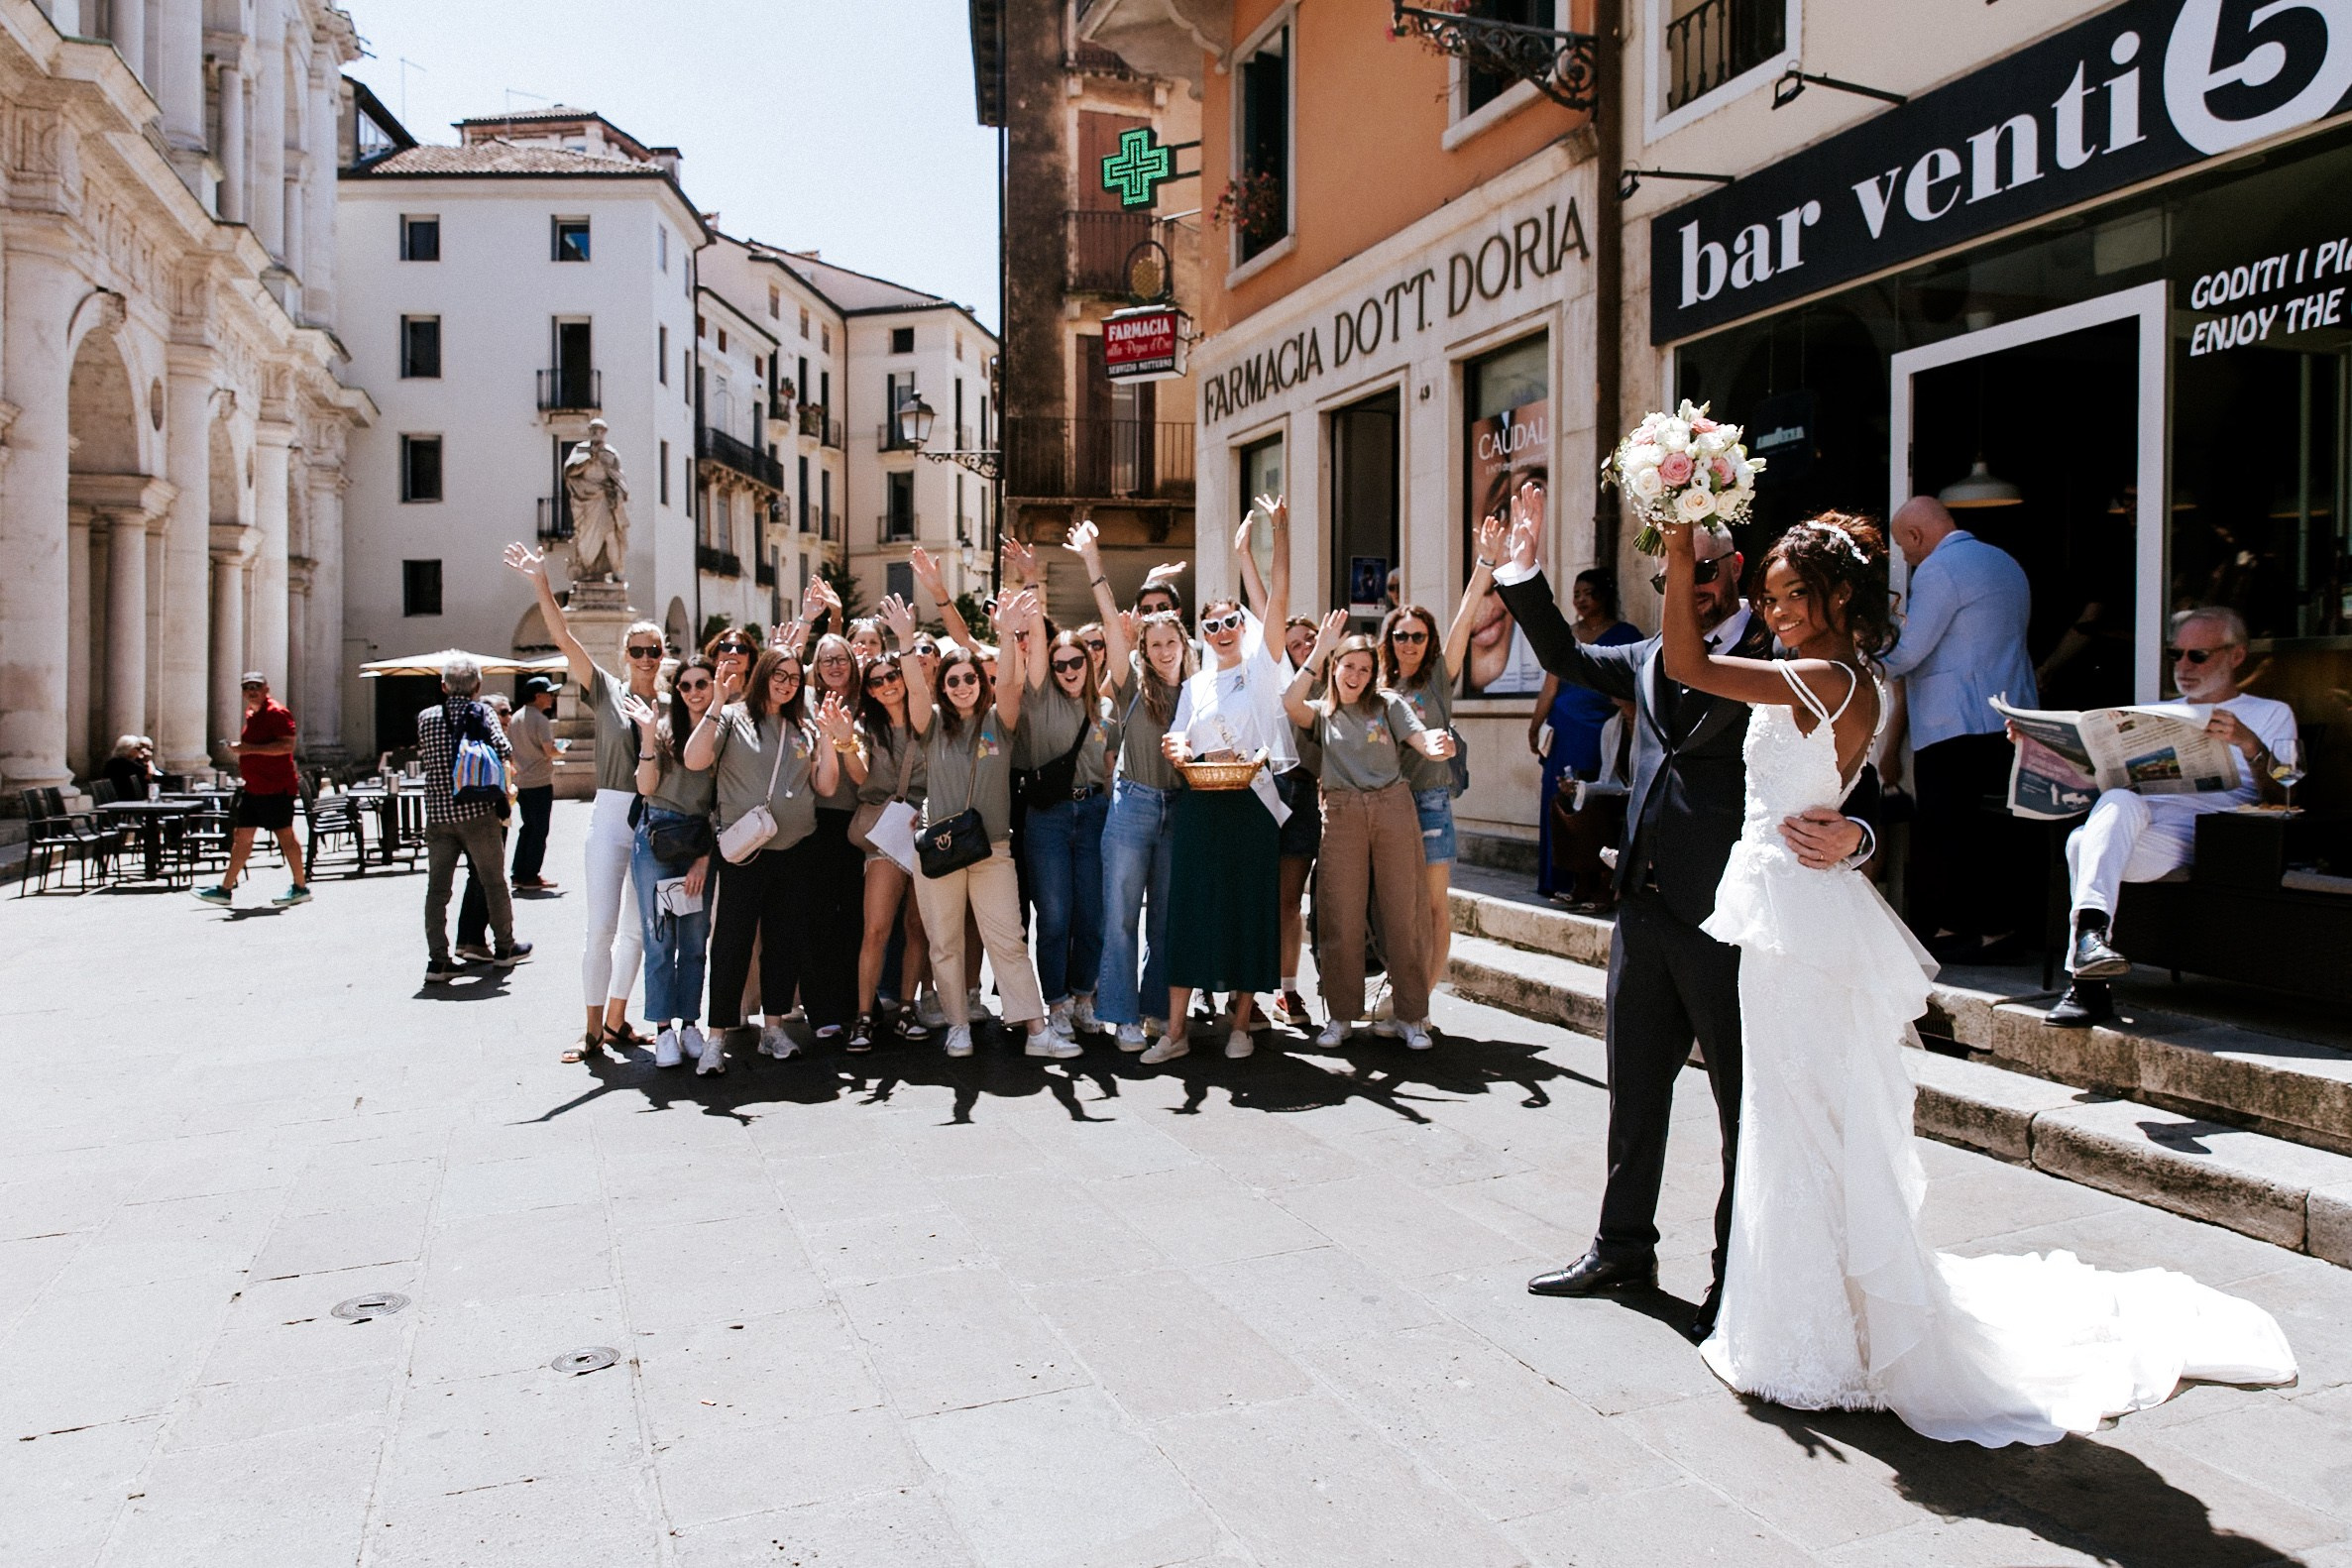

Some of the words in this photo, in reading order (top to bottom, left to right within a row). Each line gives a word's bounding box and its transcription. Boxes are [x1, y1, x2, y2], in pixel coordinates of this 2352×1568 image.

[1677, 200, 1822, 310] bar
[1851, 31, 2147, 240] venti
[2203, 0, 2328, 122] 5
[1203, 327, 1323, 426] FARMACIA
[1334, 269, 1434, 368] DOTT.
[1448, 196, 1590, 318] DORIA
[2190, 254, 2291, 310] GODITI
[2295, 248, 2309, 284] I
[1108, 317, 1171, 342] FARMACIA
[2189, 304, 2279, 357] ENJOY
[2285, 286, 2346, 334] THE
